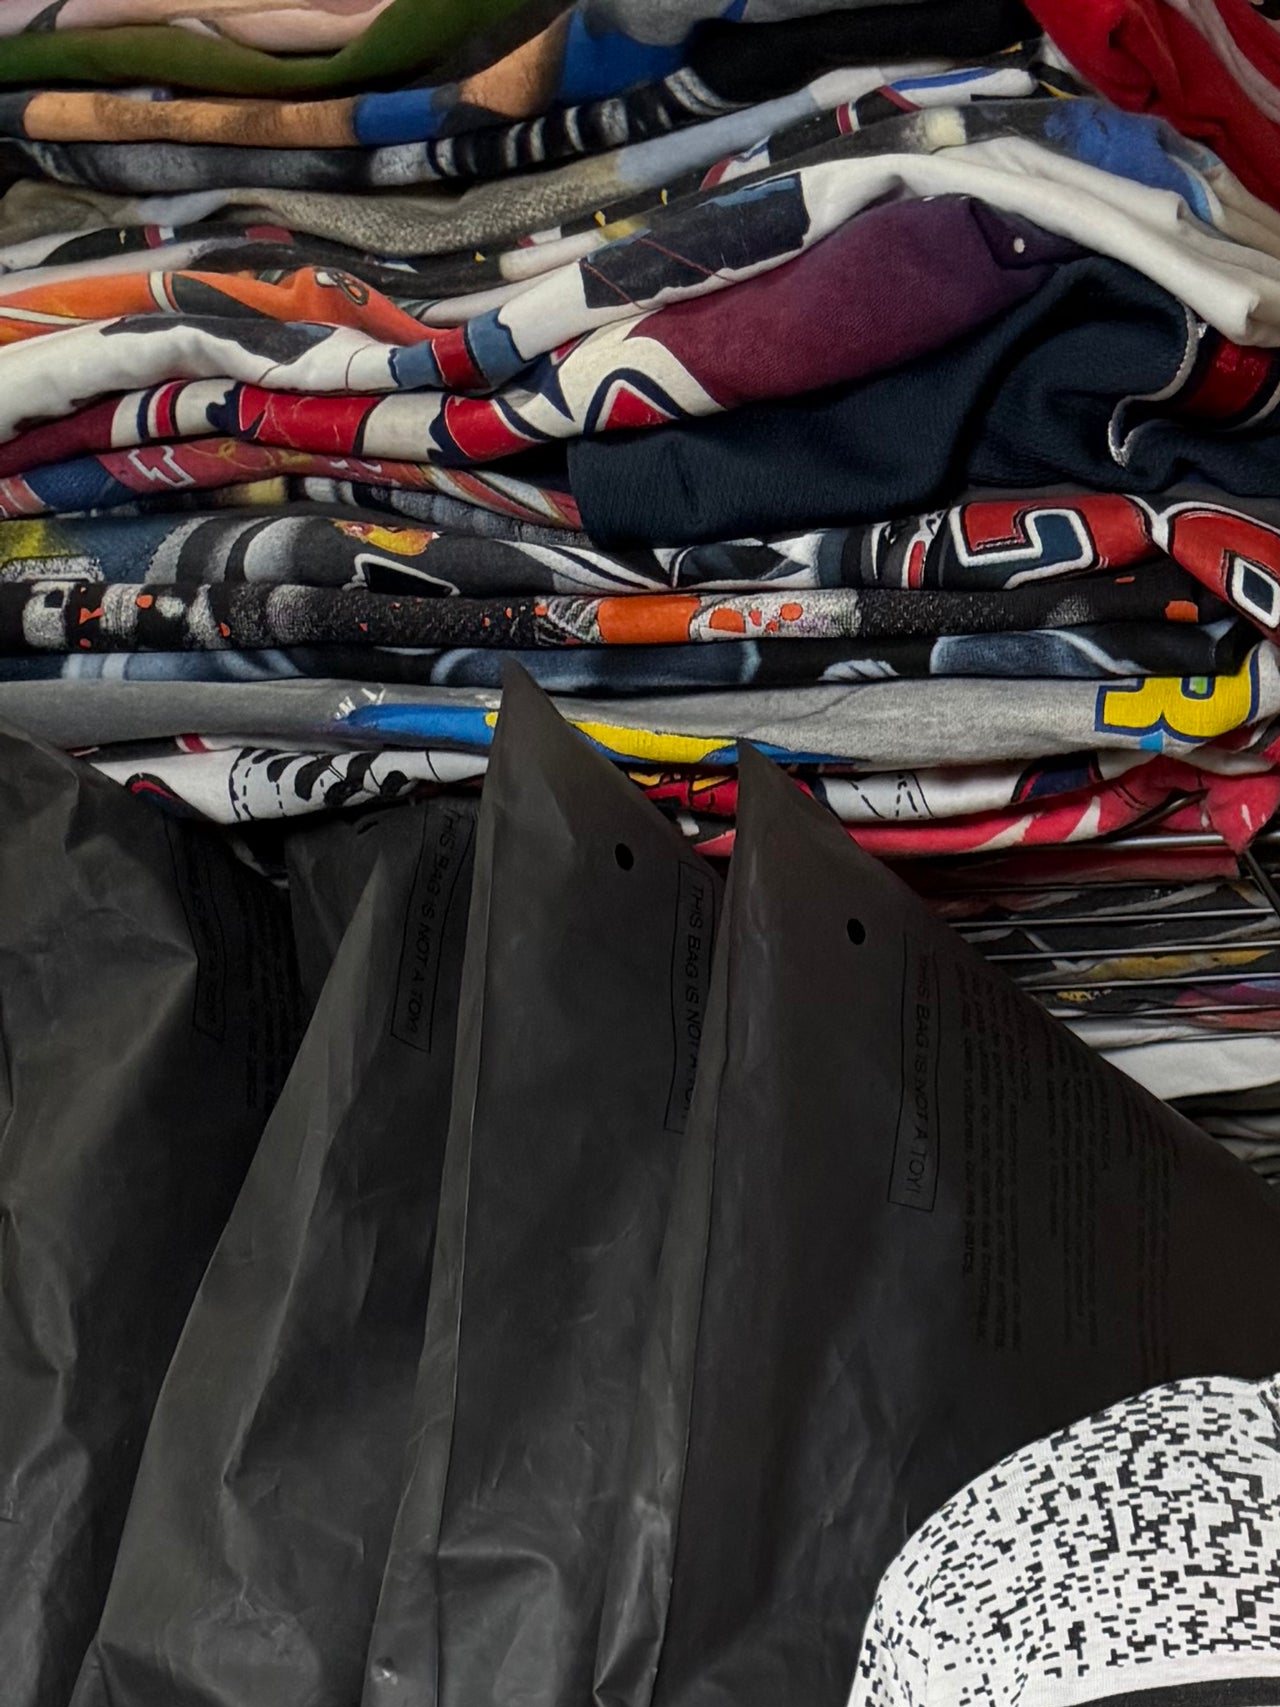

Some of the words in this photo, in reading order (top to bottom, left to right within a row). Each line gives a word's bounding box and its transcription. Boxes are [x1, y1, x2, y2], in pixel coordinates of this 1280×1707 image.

[687, 884, 704, 931] THIS
[683, 935, 703, 982] BAG
[914, 1003, 933, 1047] BAG
